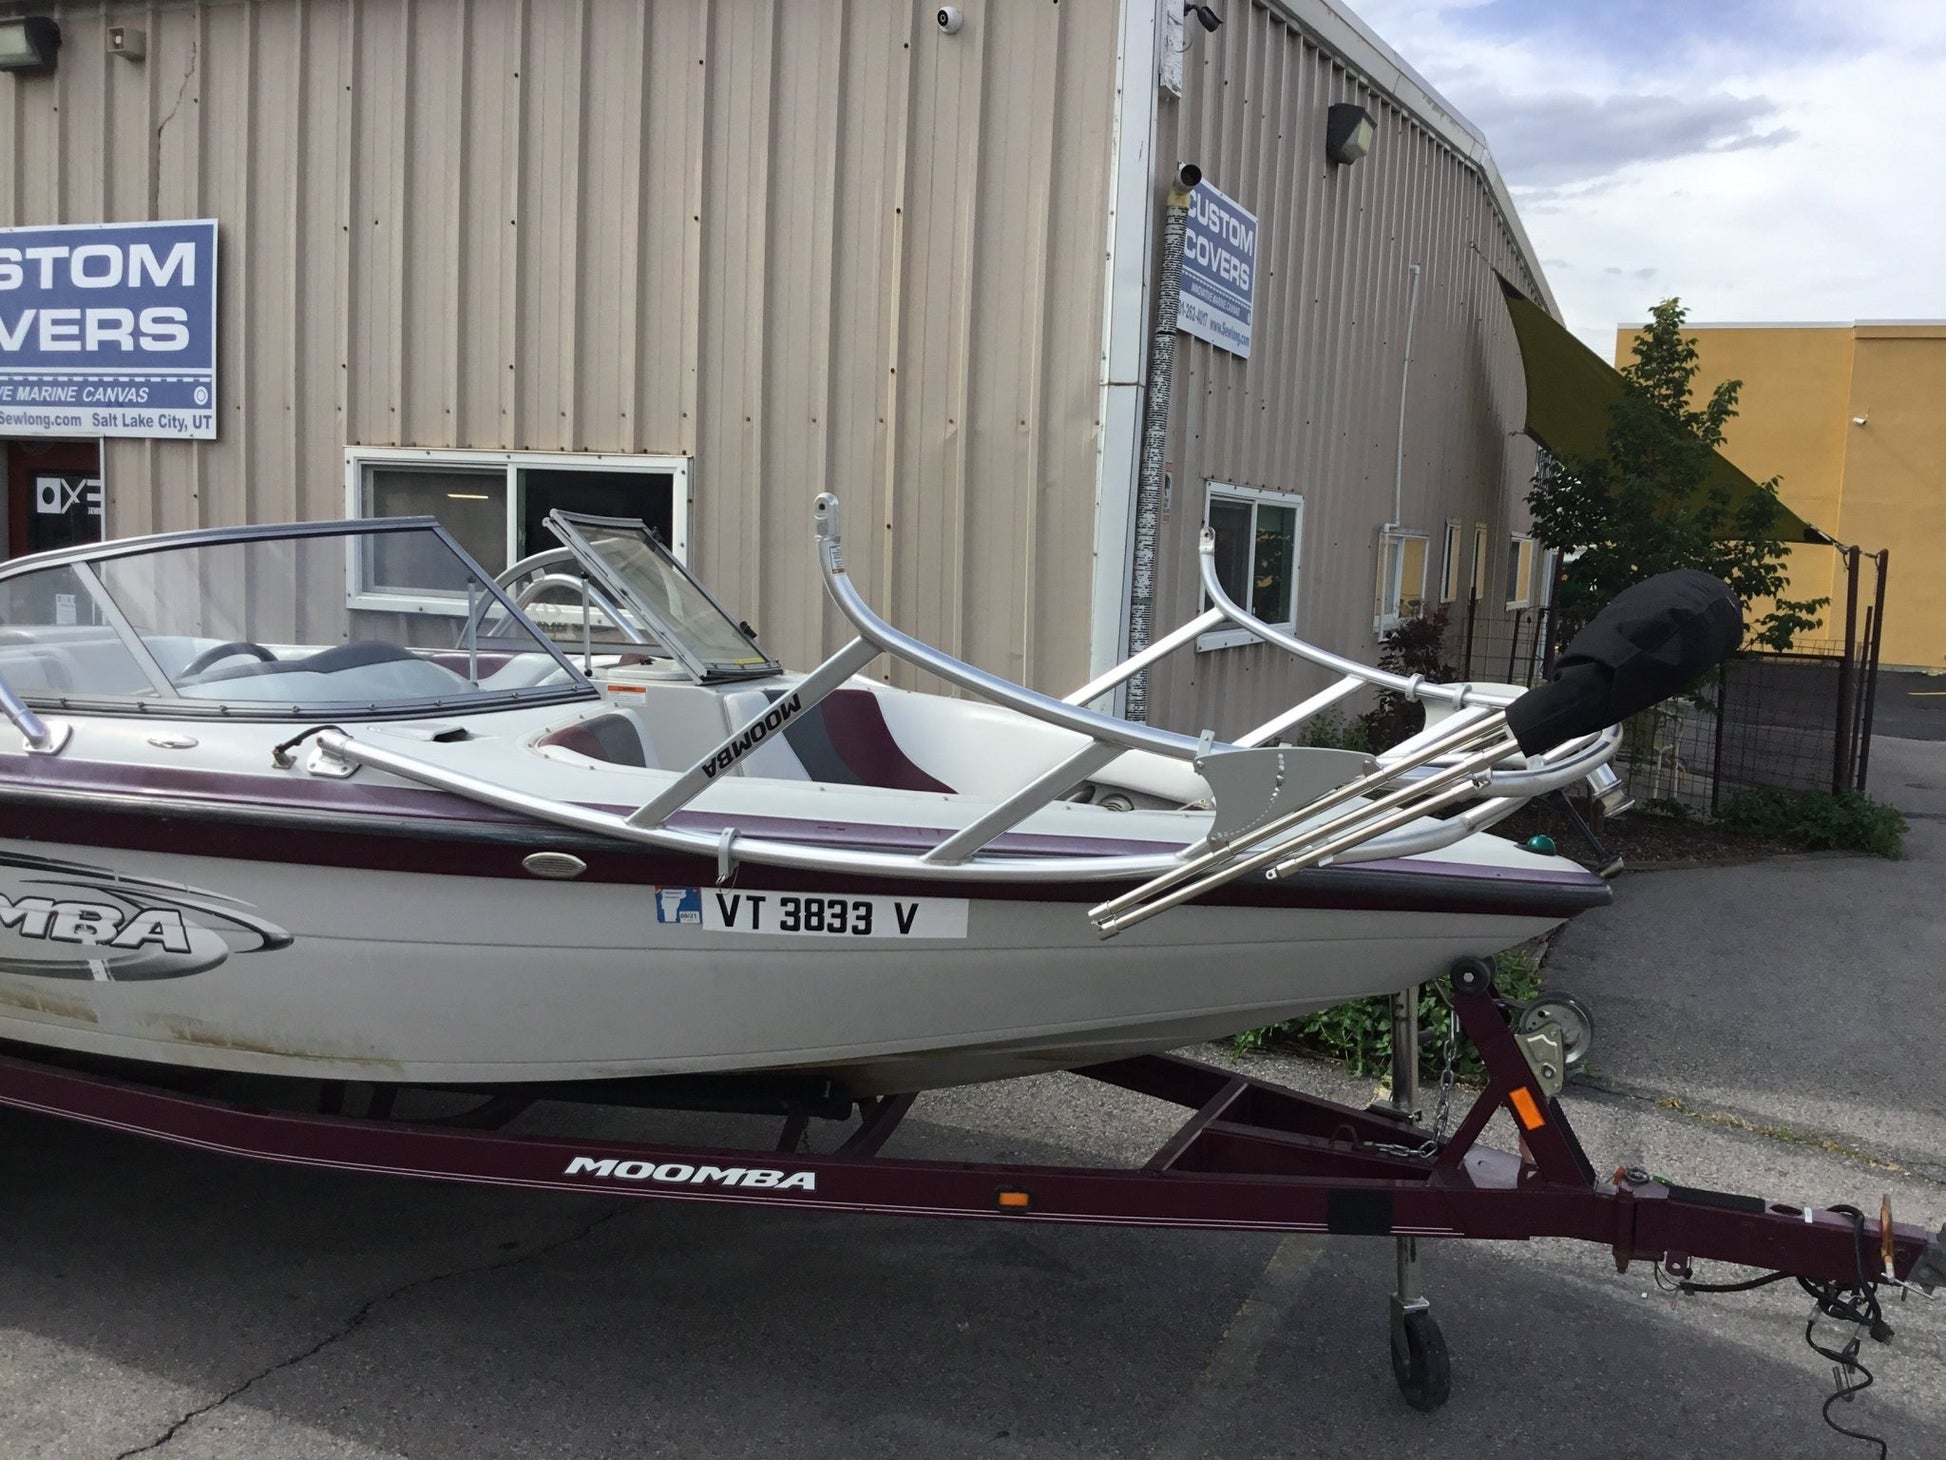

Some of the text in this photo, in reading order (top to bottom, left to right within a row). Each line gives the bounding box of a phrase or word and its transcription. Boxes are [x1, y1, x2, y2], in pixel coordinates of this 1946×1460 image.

[1187, 189, 1253, 257] CUSTOM
[1184, 227, 1250, 291] COVERS
[16, 386, 78, 401] MARINE
[82, 386, 149, 402] CANVAS
[92, 412, 118, 428] Salt
[122, 413, 154, 428] Lake
[158, 414, 188, 432] City,
[193, 415, 212, 430] UT
[702, 693, 801, 779] MOOMBA
[716, 893, 919, 935] VT 3833 V
[564, 1156, 816, 1191] MOOMBA
